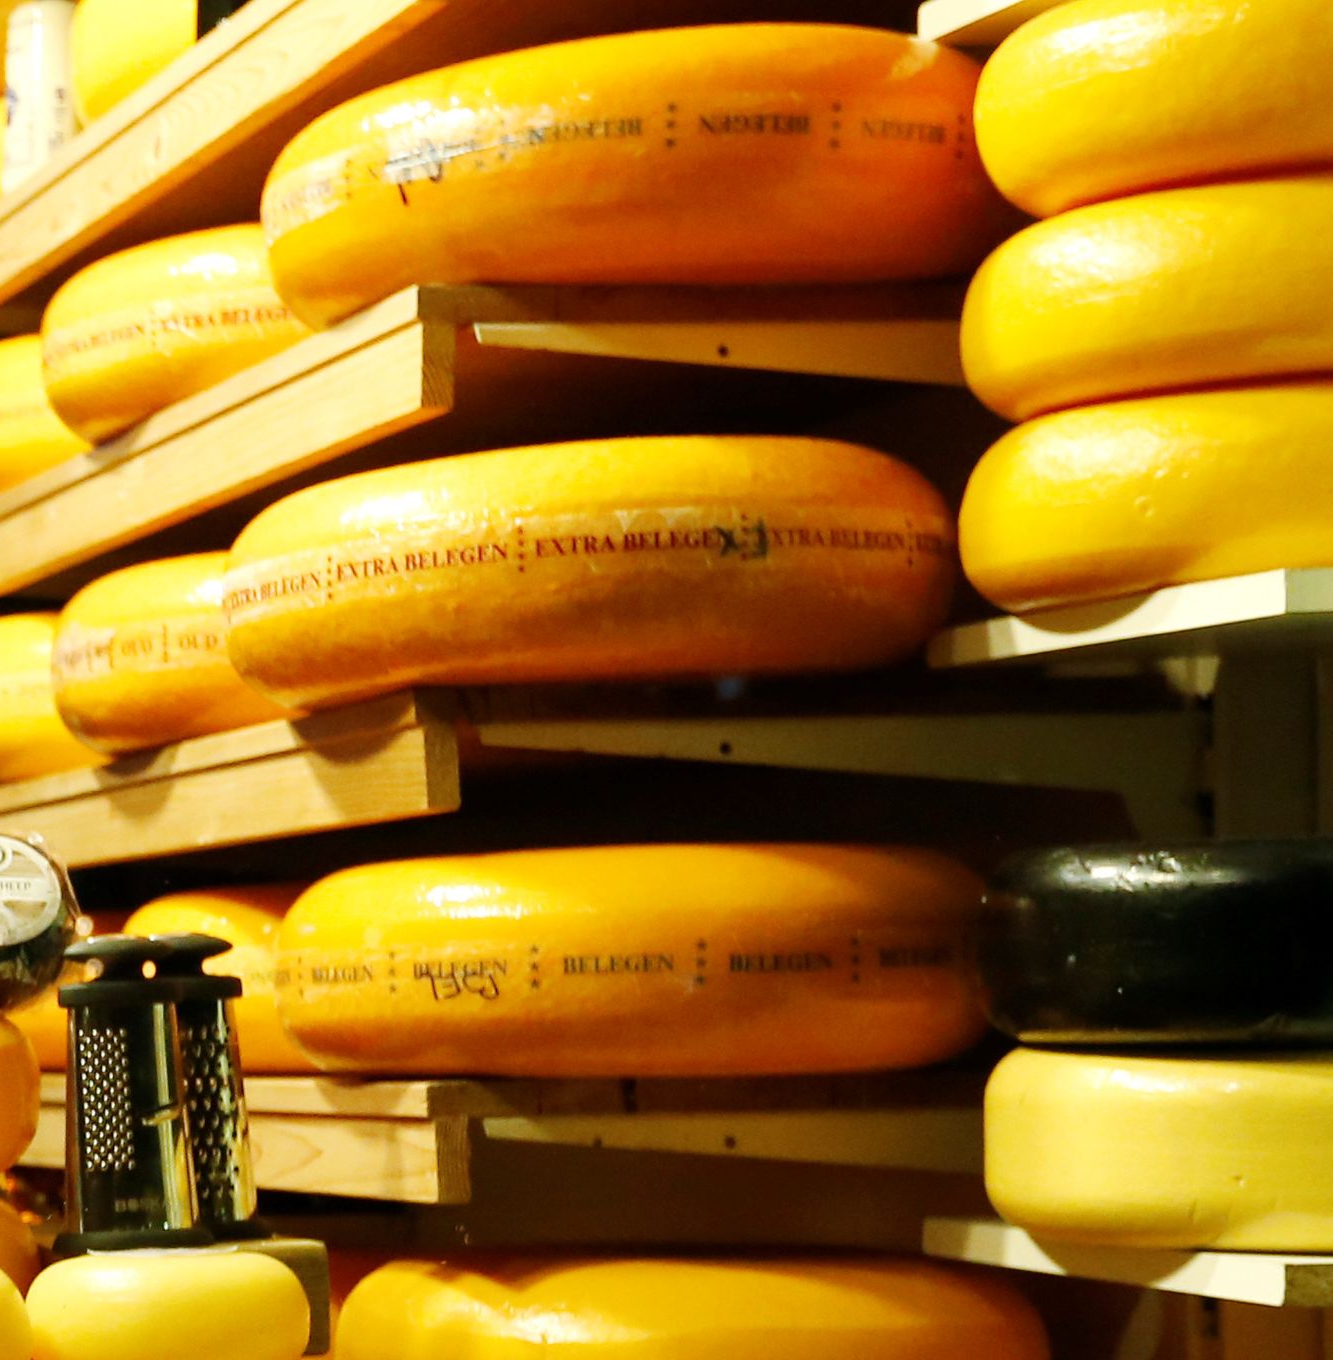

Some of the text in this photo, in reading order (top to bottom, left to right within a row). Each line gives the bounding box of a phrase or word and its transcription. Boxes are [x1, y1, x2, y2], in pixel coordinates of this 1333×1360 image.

[221, 307, 293, 326] BELEGE
[535, 534, 615, 557] EXTRA
[336, 543, 509, 581] EXTRA BELEGEN
[261, 570, 321, 600] BELEGEN
[562, 953, 675, 974] BELEGEN
[728, 952, 833, 973] BELEGEN
[311, 965, 373, 984] BELEGEN
